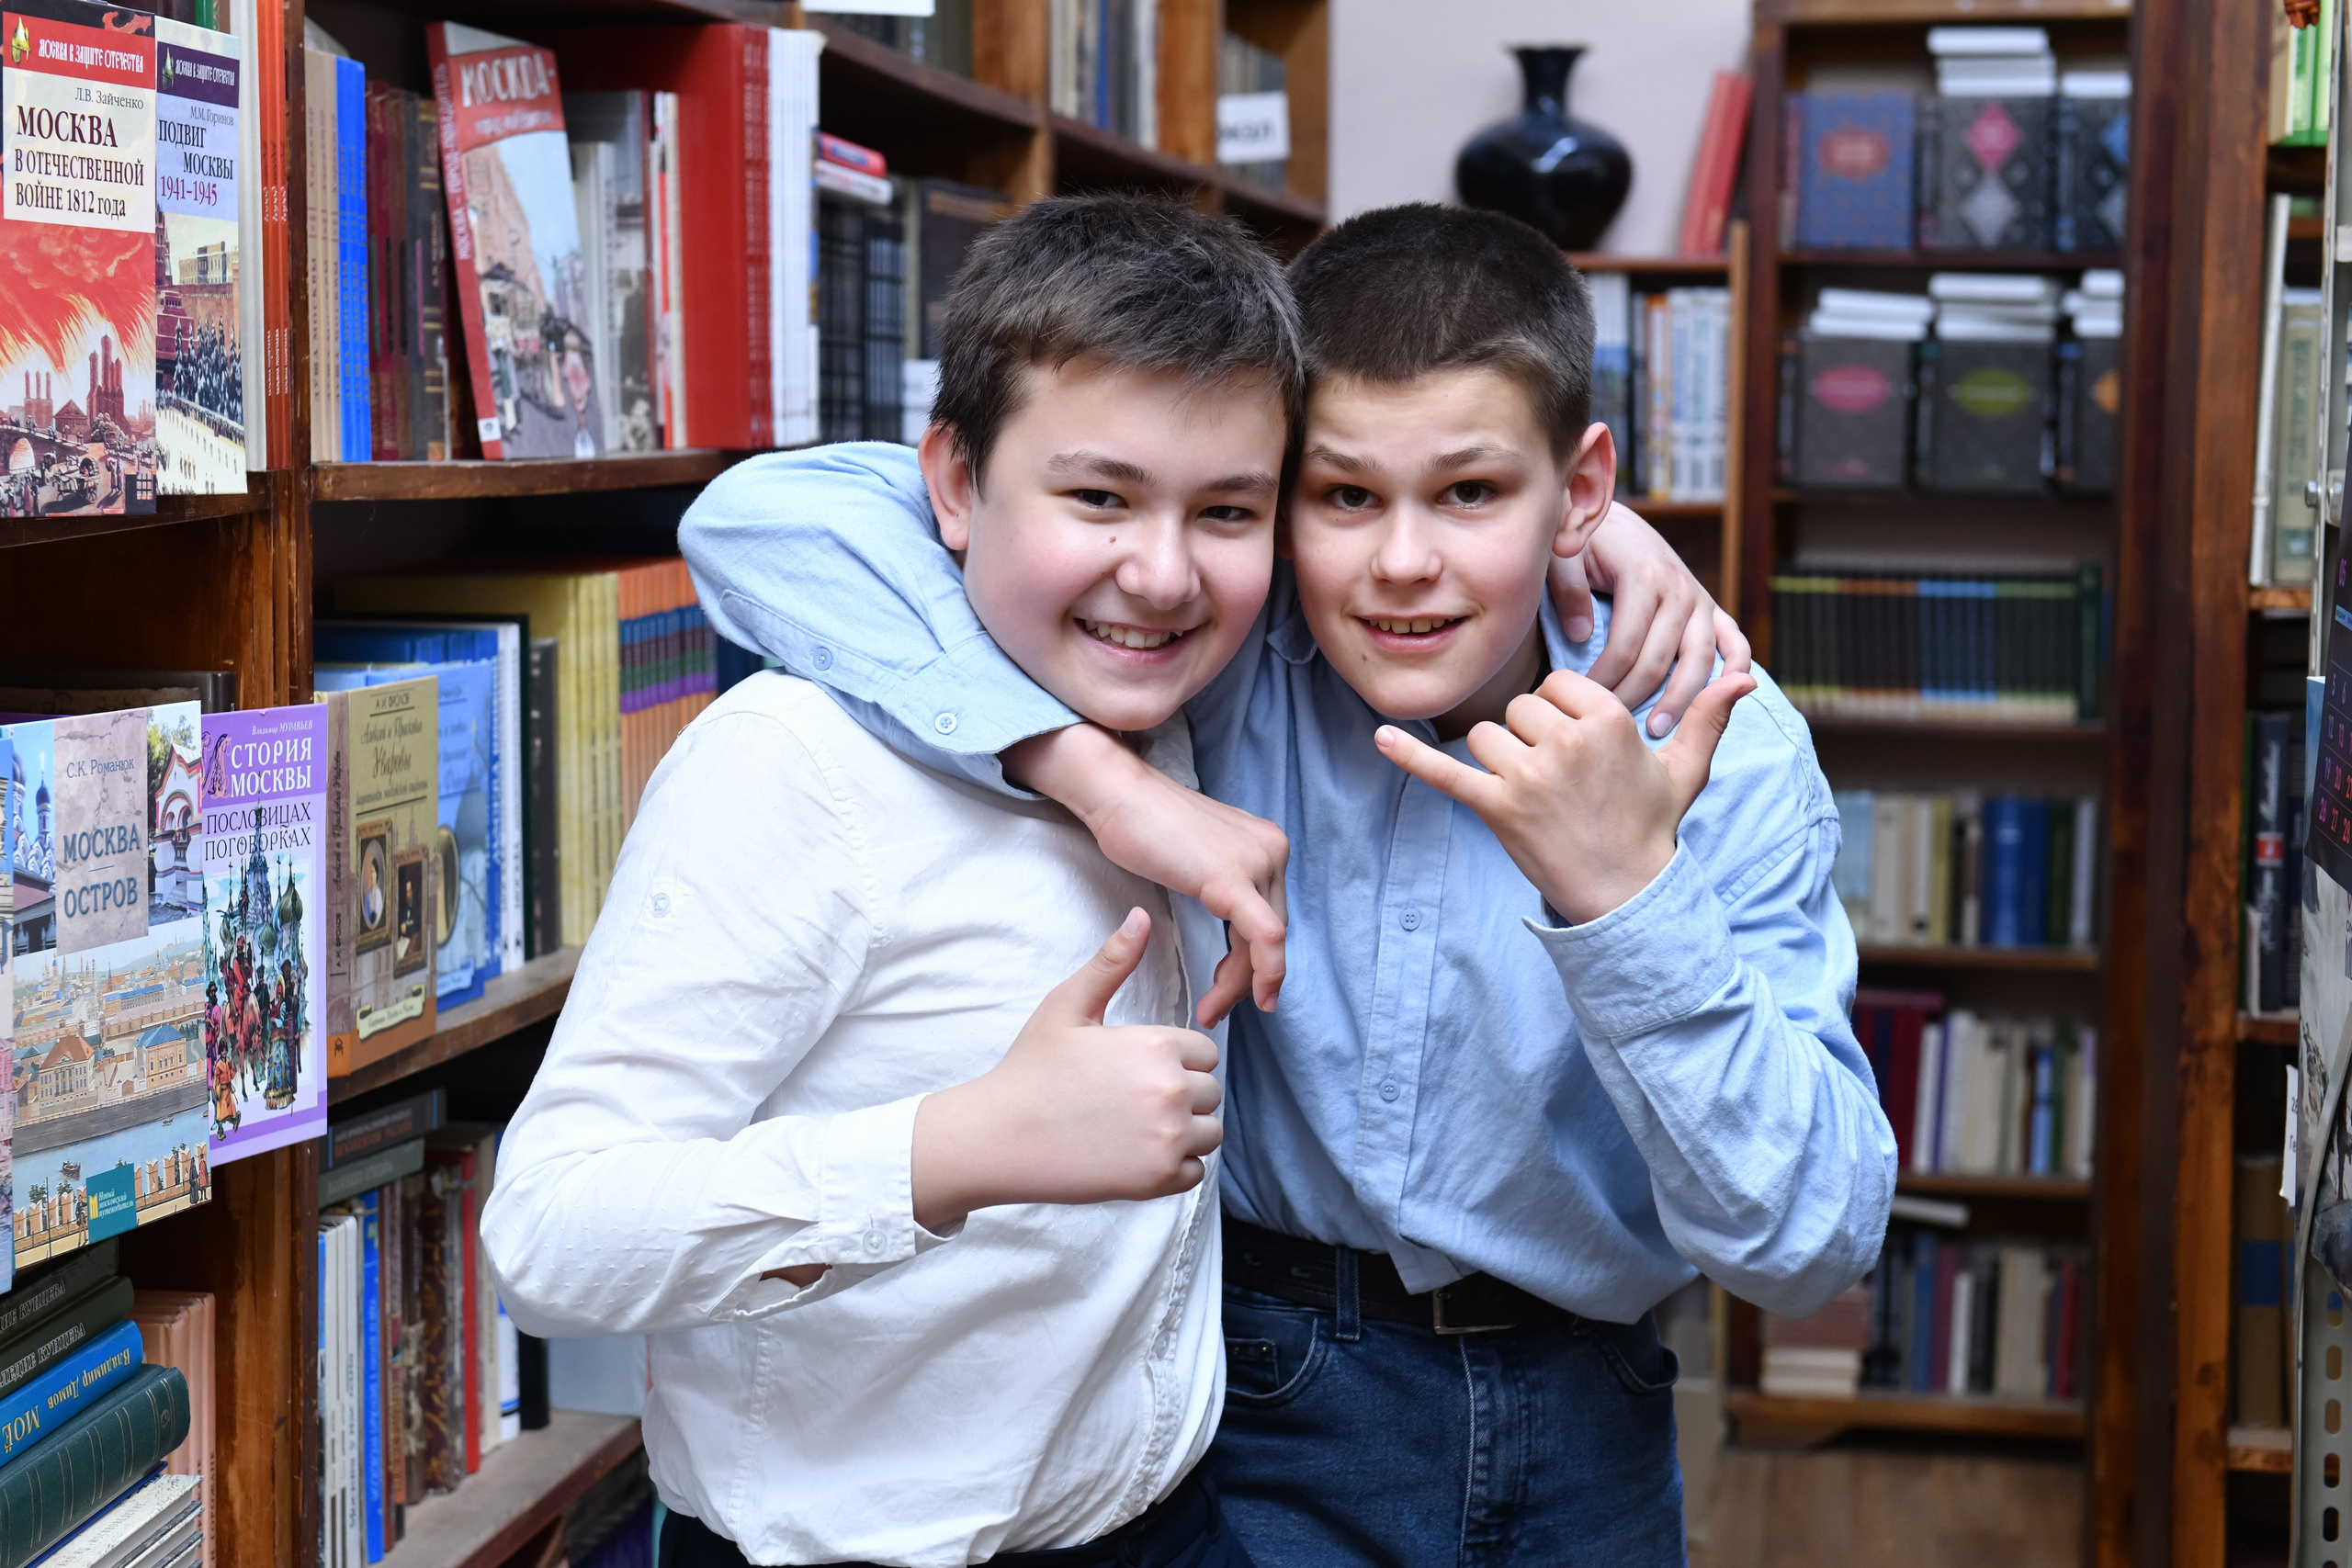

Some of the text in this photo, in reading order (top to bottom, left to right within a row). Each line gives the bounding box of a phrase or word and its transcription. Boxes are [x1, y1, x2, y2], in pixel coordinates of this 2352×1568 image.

[75, 87, 144, 109] Л.В. Зайченко
[17, 105, 118, 148] МОСКВА
[190, 106, 234, 127] М.М. Горинов
[158, 118, 207, 153] ПОДВИГ
[15, 149, 144, 186] В ОТЕЧЕСТВЕННОЙ
[183, 152, 234, 180] МОСКВЫ
[16, 180, 126, 220] ВОЙНЕ 1812 года
[452, 207, 470, 260] МОСКВА
[2331, 673, 2346, 705] 5 6
[252, 719, 313, 736] Владимир МУРАВЬЕВ
[66, 757, 135, 779] С.К. Романюк
[231, 764, 311, 798] МОСКВЫ
[206, 802, 311, 835] ПОСЛОВИЦАХ
[2318, 797, 2351, 844] 26 27 28
[62, 823, 141, 863] МОСКВА
[205, 827, 311, 862] ПОГОВОРКАХ
[63, 876, 139, 919] ОСТРОВ
[98, 1188, 115, 1201] Новый
[98, 1192, 127, 1209] московский
[98, 1201, 134, 1218] путеводитель
[19, 1280, 66, 1320] КУНЦЕВА
[39, 1322, 86, 1364] КУНЦЕВА
[47, 1348, 130, 1410] Владимир Димов
[1, 1404, 41, 1454] МОЁ
